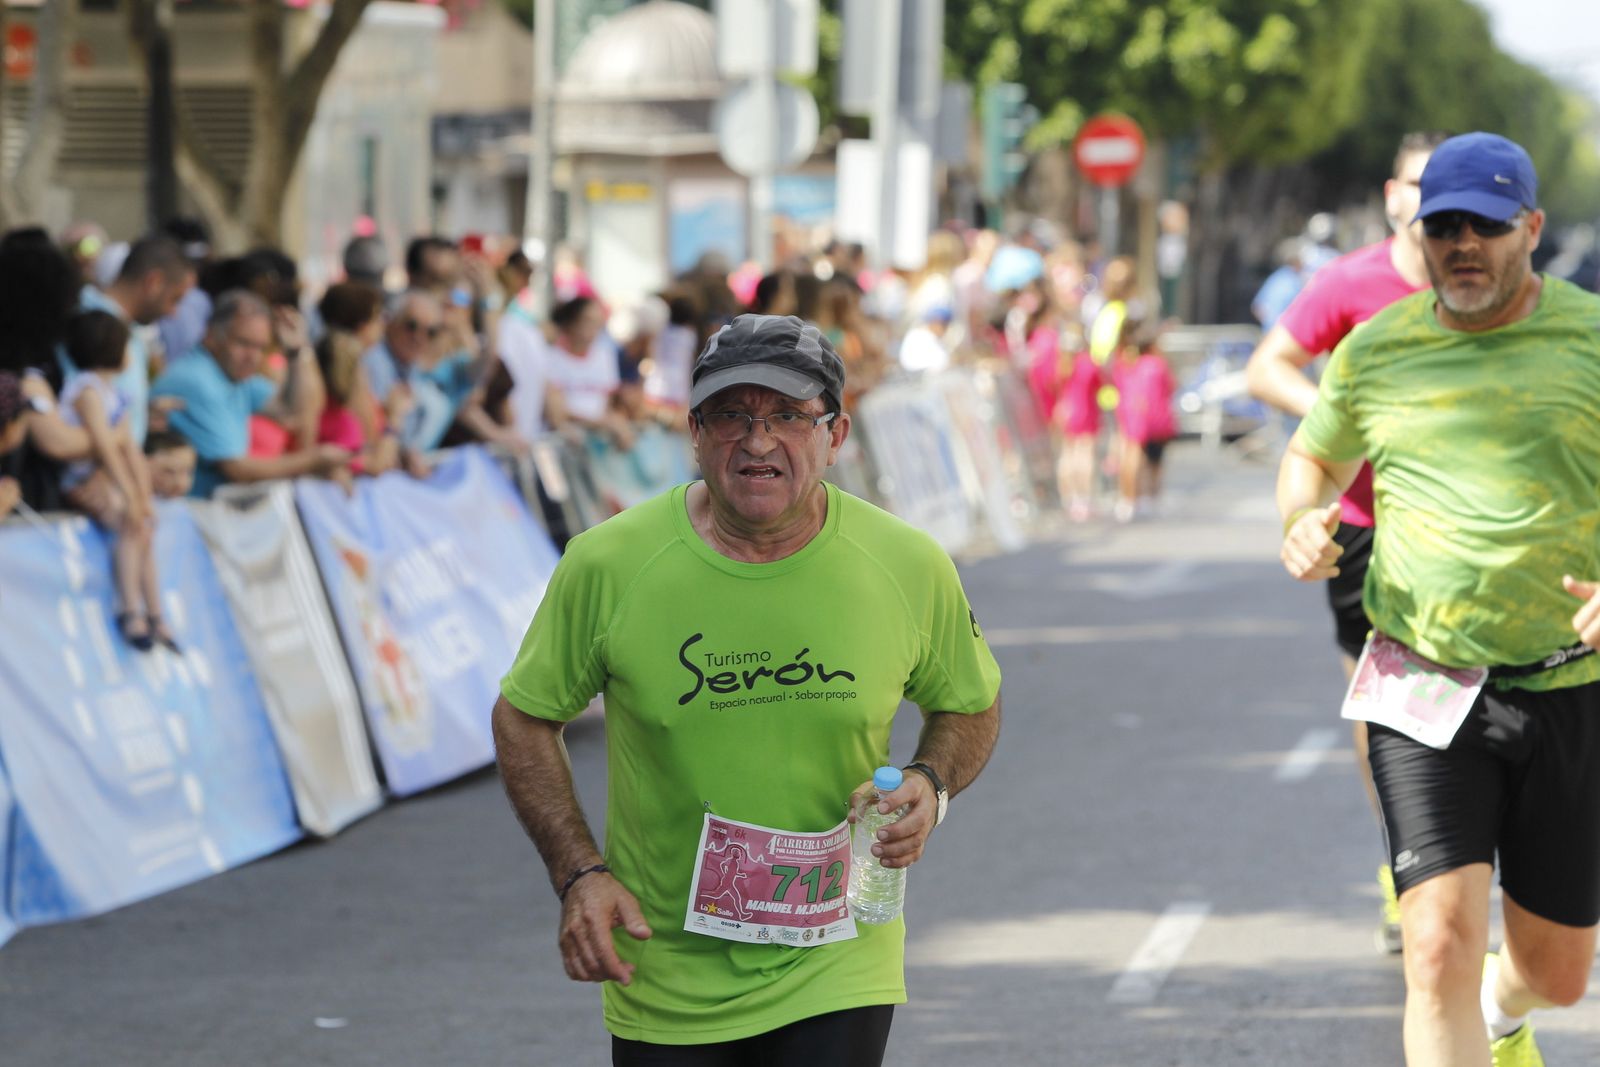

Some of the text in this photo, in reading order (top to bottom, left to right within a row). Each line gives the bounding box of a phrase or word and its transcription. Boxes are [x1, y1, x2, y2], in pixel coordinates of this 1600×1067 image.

[704, 650, 771, 667] Turismo
[678, 632, 856, 706] Serón
[710, 689, 857, 712] Espacio natural Sabor propio
[776, 836, 820, 850] CARRERA
[771, 860, 844, 903] 712
[745, 899, 792, 914] MANUEL
